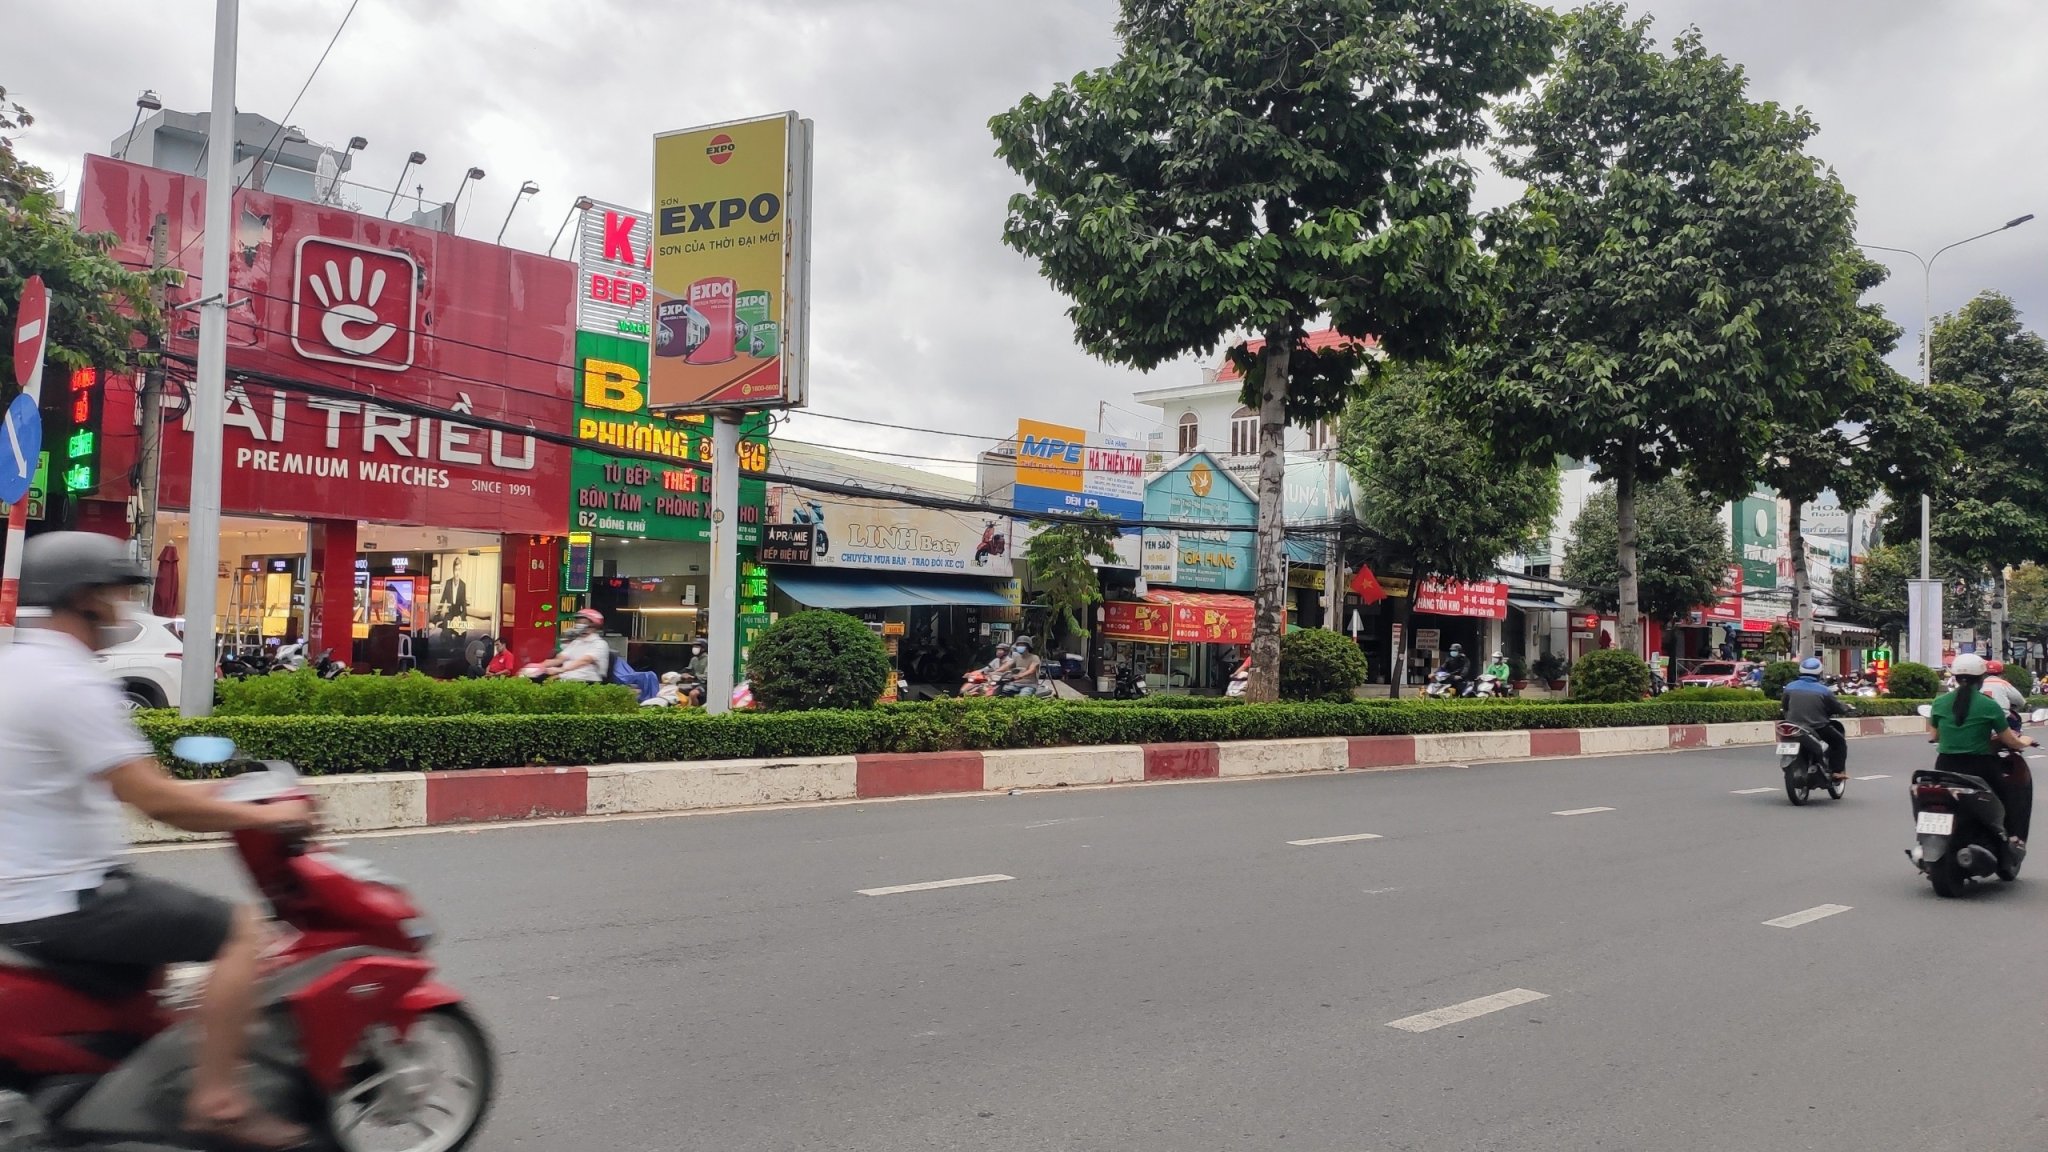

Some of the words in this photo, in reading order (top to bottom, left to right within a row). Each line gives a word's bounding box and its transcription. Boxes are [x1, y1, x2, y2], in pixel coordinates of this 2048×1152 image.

[706, 143, 736, 155] EXPO
[659, 192, 781, 236] EXPO
[660, 197, 679, 207] SƠN
[659, 245, 682, 256] SƠN
[684, 239, 706, 254] CỦA
[709, 236, 735, 250] THỜI
[738, 235, 756, 248] ĐẠI
[759, 229, 780, 244] MỚI
[591, 269, 647, 308] BẾP
[690, 281, 733, 300] EXPO
[735, 294, 766, 308] EXPO
[753, 322, 777, 332] EXPO
[306, 391, 536, 471] TRIỀU
[579, 418, 689, 460] PHƯƠNG
[1020, 433, 1083, 464] MPE
[237, 447, 349, 479] PREMIUM
[359, 460, 450, 489] WATCHES
[471, 479, 502, 494] SINCE
[508, 483, 532, 497] 1991
[604, 460, 622, 484] TỦ
[625, 463, 651, 487] BẾP
[662, 468, 698, 492] THIẾT
[579, 484, 608, 509] BỒN
[612, 486, 642, 512] TẮM
[655, 494, 699, 519] PHÒNG
[739, 505, 759, 524] HƠI
[578, 511, 598, 528] 62
[847, 523, 919, 551] LINH
[841, 552, 873, 564] CHUYÊN
[874, 556, 891, 565] MUA
[891, 555, 907, 566] BÁN
[911, 557, 930, 567] TRAO
[944, 559, 955, 568] XE
[1820, 635, 1842, 647] HOA
[1844, 635, 1874, 649] florist
